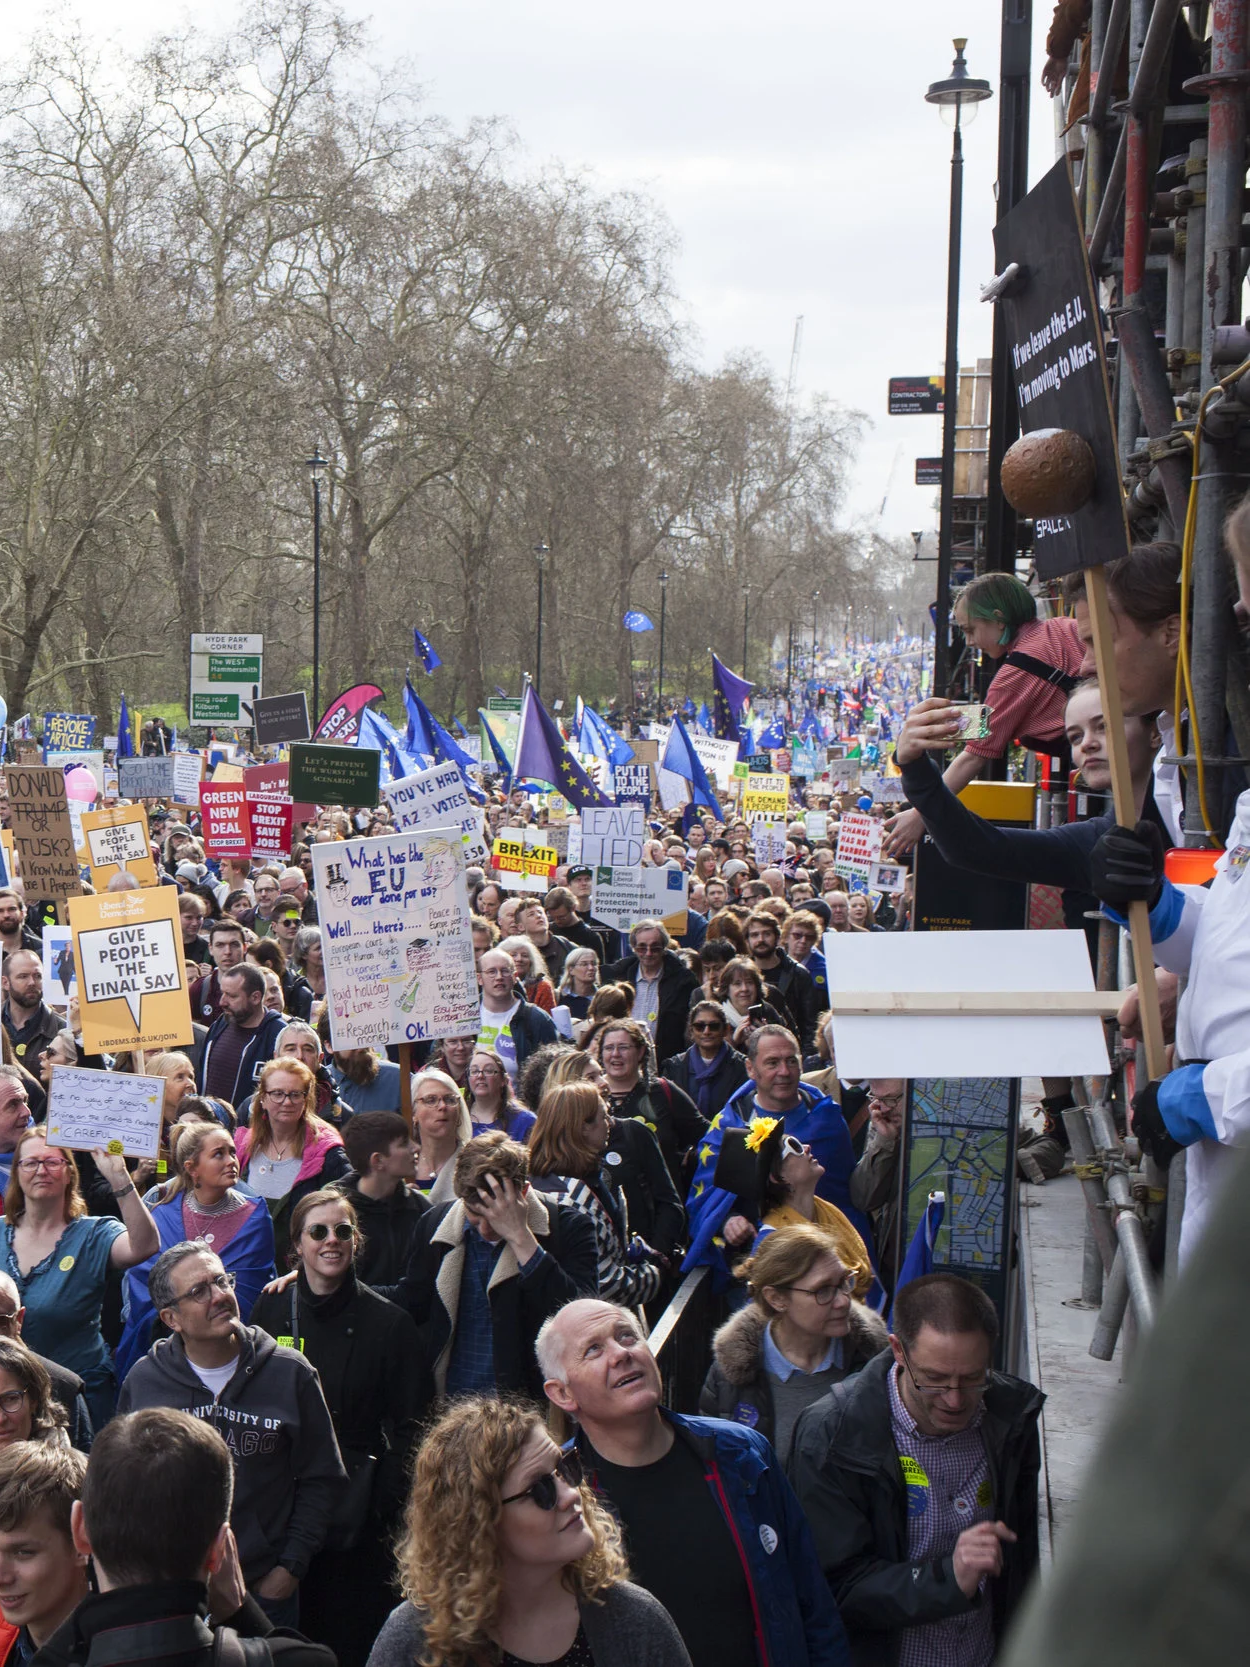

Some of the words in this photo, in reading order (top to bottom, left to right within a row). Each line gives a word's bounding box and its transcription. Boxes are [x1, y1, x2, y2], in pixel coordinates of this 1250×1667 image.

[1020, 341, 1031, 364] we
[1030, 325, 1051, 356] leave
[1050, 312, 1066, 339] the
[1066, 296, 1086, 328] E.U.
[1019, 383, 1032, 408] I'm
[1031, 363, 1061, 399] moving
[1059, 356, 1070, 378] to
[1069, 341, 1097, 372] Mars.
[321, 707, 346, 738] STOP
[49, 731, 86, 749] ARTICLE
[615, 766, 635, 776] PUT
[638, 766, 647, 776] IT
[8, 771, 66, 797] DONALD
[615, 776, 627, 785] TO
[631, 776, 648, 785] THE
[390, 780, 434, 805] YOU'VE
[435, 771, 460, 789] HAD
[616, 786, 649, 795] PEOPLE
[202, 791, 244, 804] GREEN
[432, 792, 467, 814] VOTES
[11, 801, 69, 821] TRUMP
[209, 807, 239, 819] NEW
[256, 804, 282, 814] STOP
[252, 815, 287, 826] BREXIT
[582, 811, 644, 835] LEAVE
[746, 810, 785, 823] VOTE
[843, 816, 871, 826] CLIMATE
[32, 820, 50, 832] OR
[105, 827, 127, 836] GIVE
[210, 822, 242, 834] DEAL
[256, 826, 280, 837] SAVE
[842, 826, 870, 837] CHANGE
[100, 834, 136, 846] PEOPLE
[255, 838, 281, 848] JOBS
[16, 838, 70, 857] TUSK?
[110, 844, 129, 853] THE
[499, 842, 554, 861] BREXIT
[581, 838, 642, 867] LIED
[97, 853, 125, 864] FINAL
[127, 849, 145, 858] SAY
[346, 846, 385, 869] What
[387, 846, 407, 865] has
[409, 842, 424, 862] the
[500, 858, 550, 877] DISASTER
[368, 867, 405, 894] EU
[351, 894, 374, 906] ever
[379, 890, 402, 904] done
[596, 891, 655, 899] Environmental
[100, 901, 126, 911] Liberal
[595, 907, 630, 915] Stronger
[100, 909, 145, 919] Democrats
[429, 908, 450, 919] Peace
[109, 929, 145, 945] GIVE
[99, 943, 159, 963] PEOPLE
[116, 961, 146, 977] THE
[92, 978, 140, 996] FINAL
[145, 973, 174, 989] SAY
[354, 980, 389, 999] holiday
[346, 1018, 389, 1038] Research
[99, 1033, 177, 1047] LIBDEMS.ORG.UK/JOIN
[357, 1033, 389, 1046] money
[63, 1127, 113, 1139] CAREFUL
[264, 1418, 281, 1430] OF
